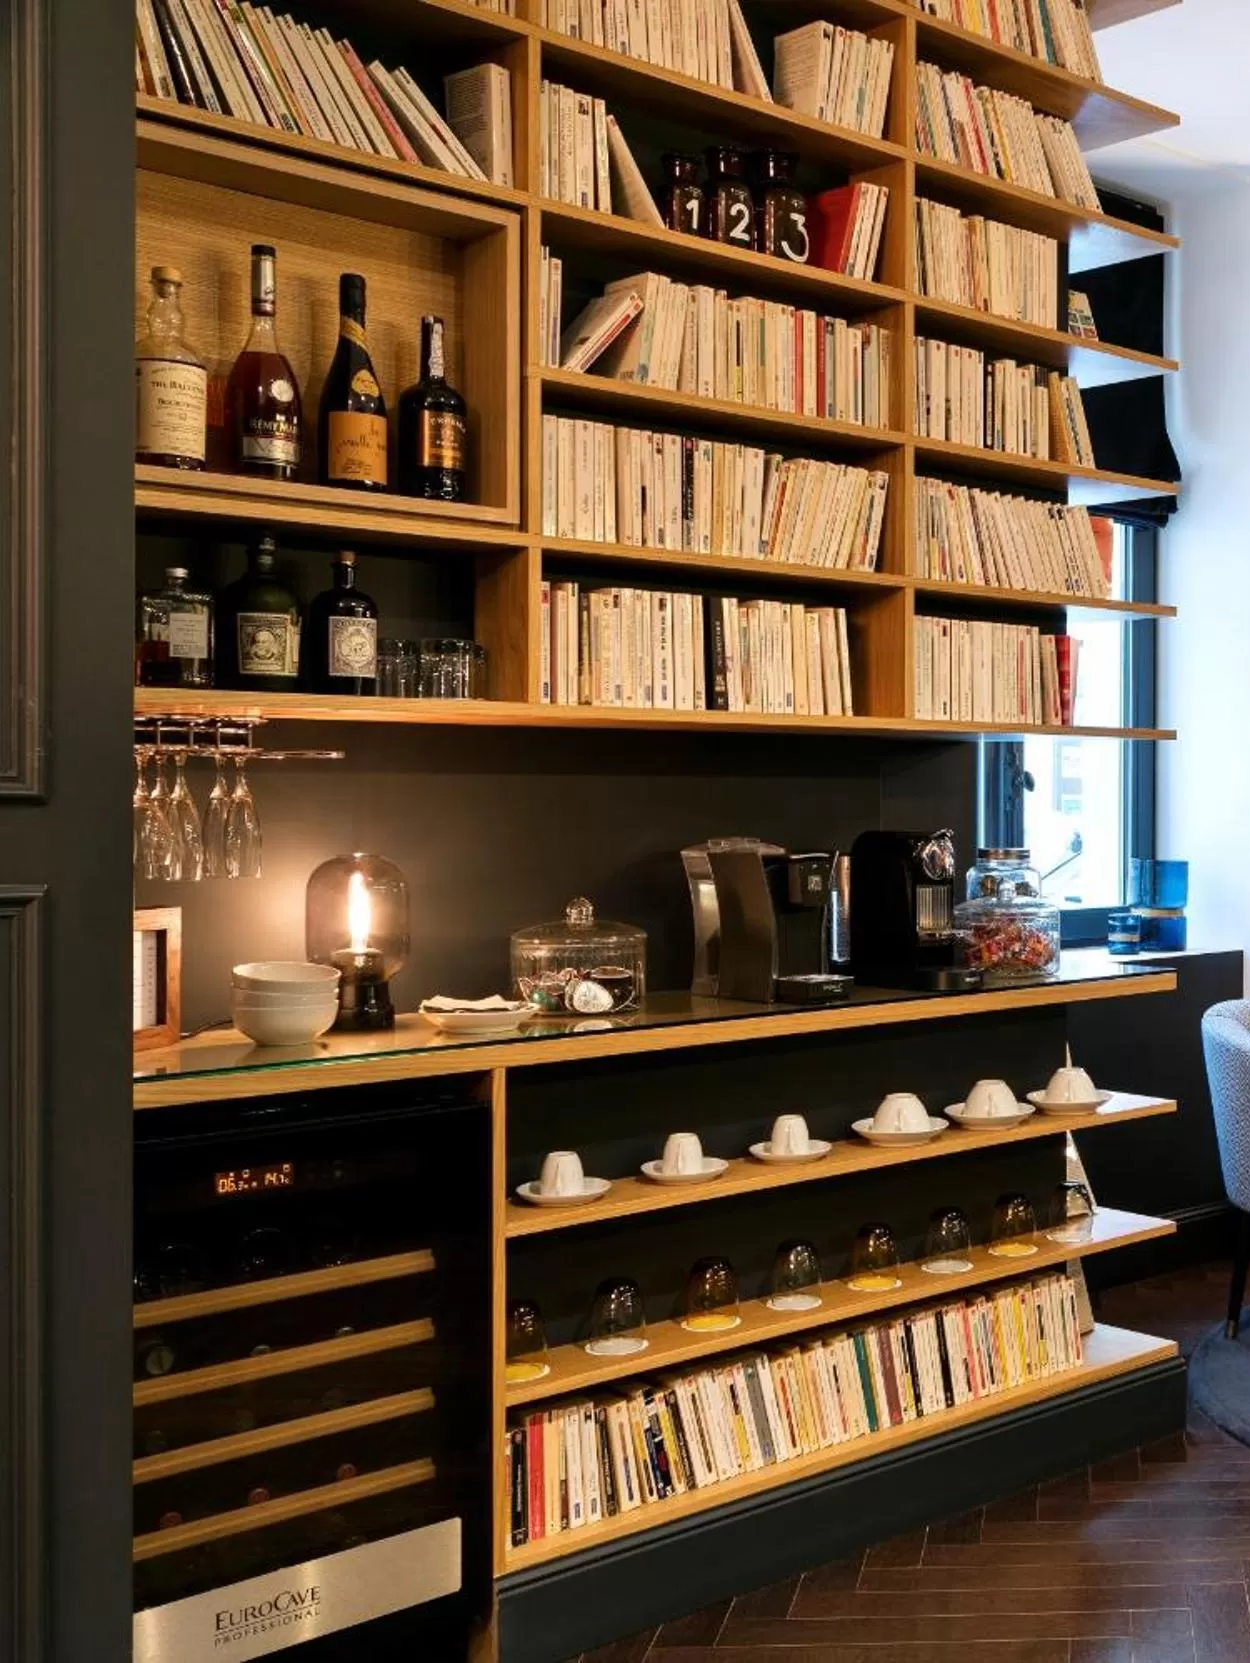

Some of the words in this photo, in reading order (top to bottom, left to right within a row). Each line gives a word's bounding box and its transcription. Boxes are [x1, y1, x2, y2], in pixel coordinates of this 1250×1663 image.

[686, 199, 700, 230] 1
[730, 203, 751, 241] 2
[781, 212, 809, 263] 3
[214, 1608, 320, 1648] PROFESSIONAL
